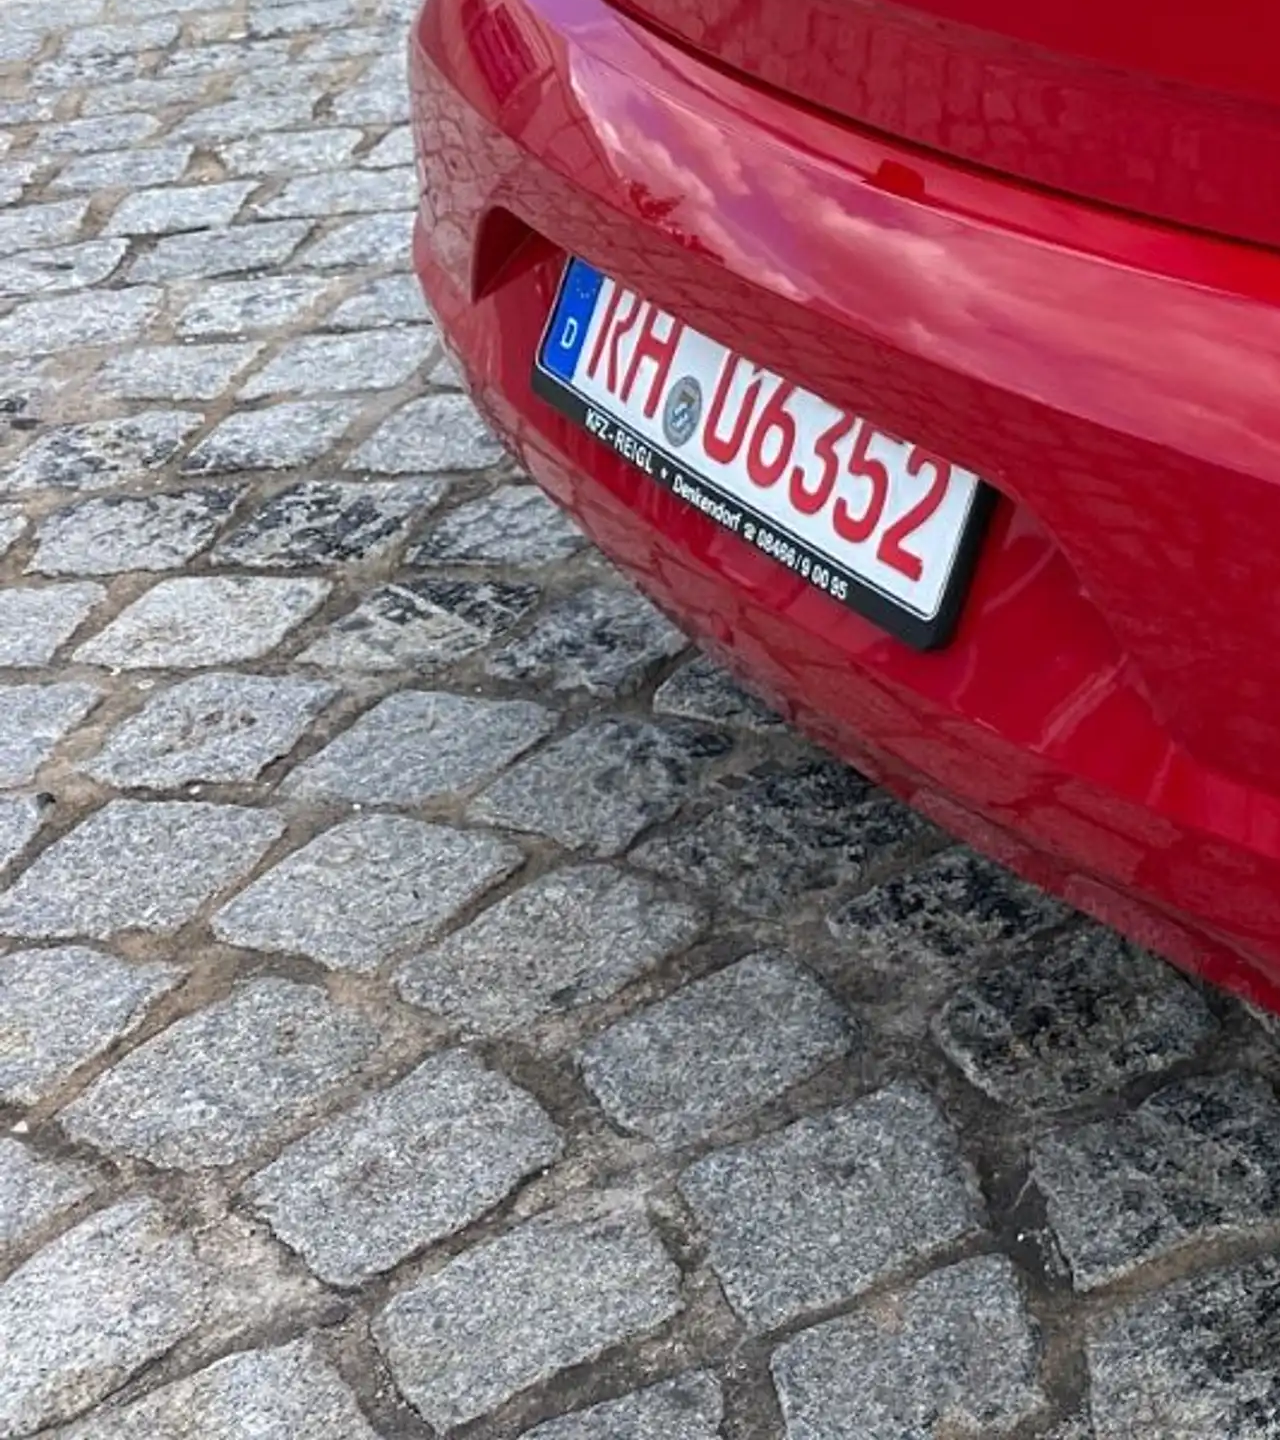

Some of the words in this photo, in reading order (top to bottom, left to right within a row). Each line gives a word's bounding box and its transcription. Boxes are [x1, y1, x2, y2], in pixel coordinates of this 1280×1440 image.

[560, 316, 578, 350] D
[586, 280, 684, 420] RH
[703, 352, 951, 582] 06352
[672, 474, 743, 532] Denkendorf
